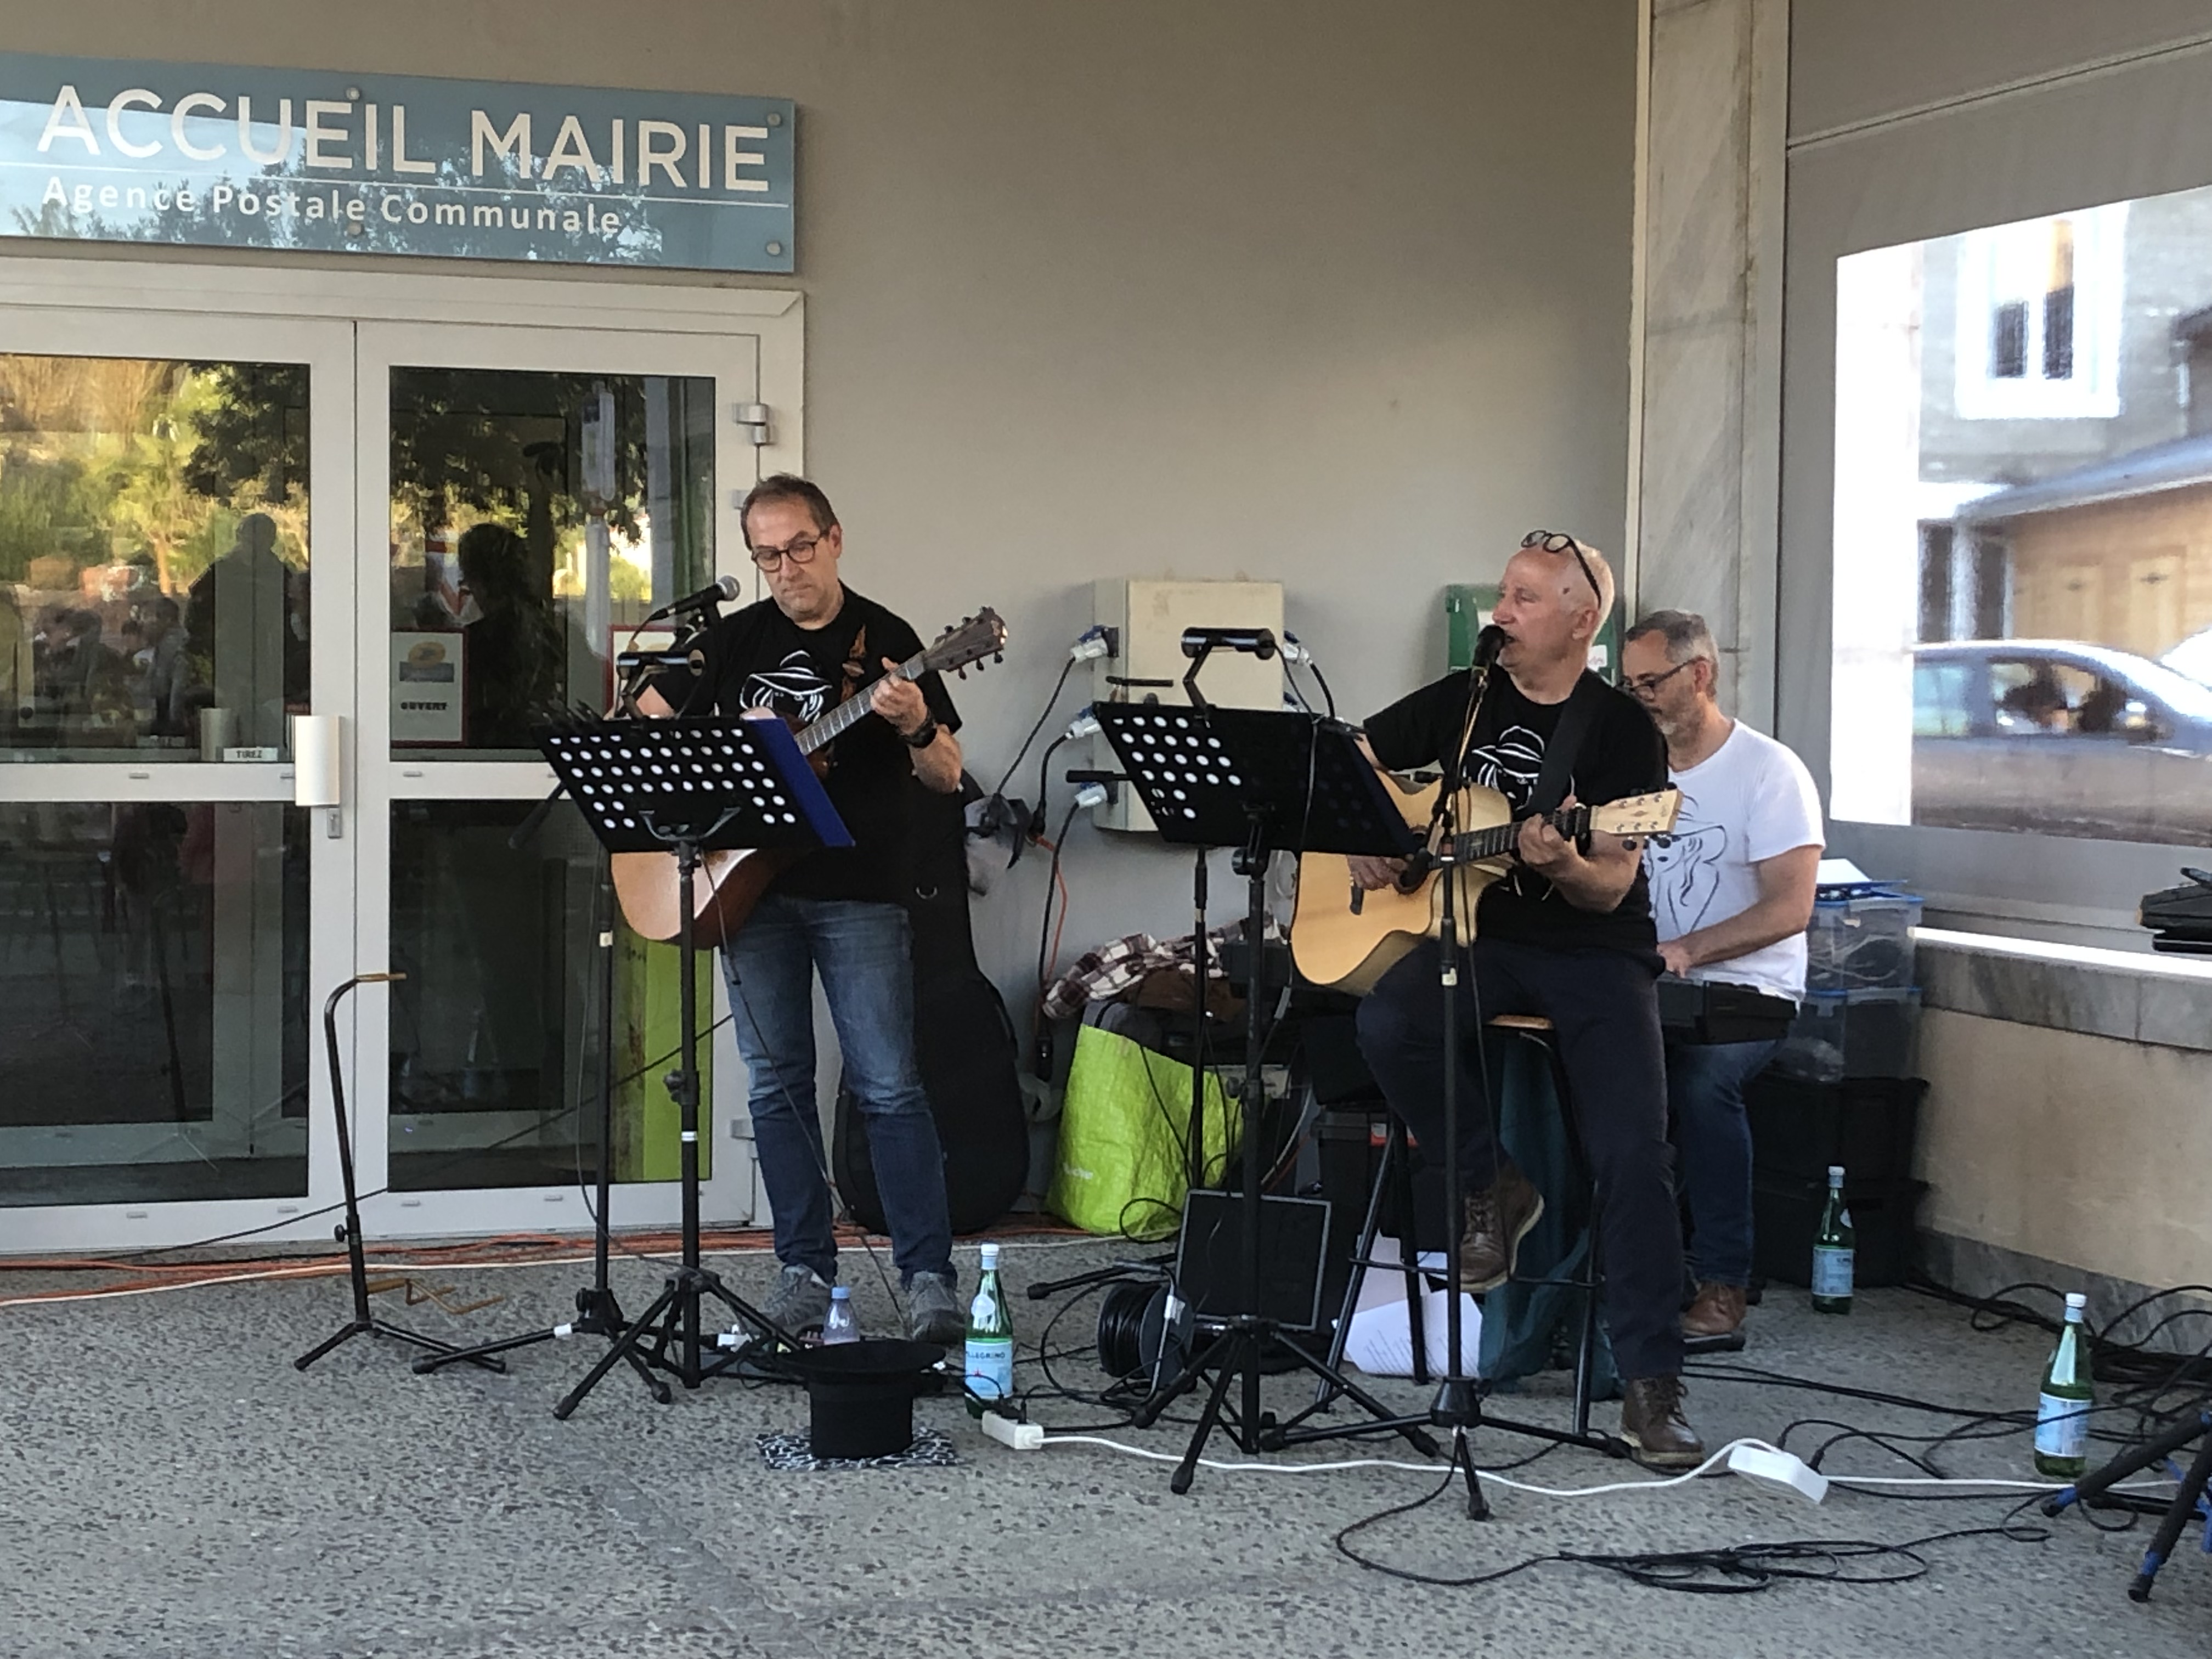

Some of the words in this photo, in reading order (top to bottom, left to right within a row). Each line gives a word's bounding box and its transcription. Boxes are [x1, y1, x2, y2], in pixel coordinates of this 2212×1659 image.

[37, 85, 436, 173] ACCUEIL
[471, 110, 769, 191] MAIRIE
[42, 177, 195, 213] Agence
[213, 186, 365, 221] Postale
[382, 198, 620, 234] Communale
[400, 702, 448, 711] OUVERT
